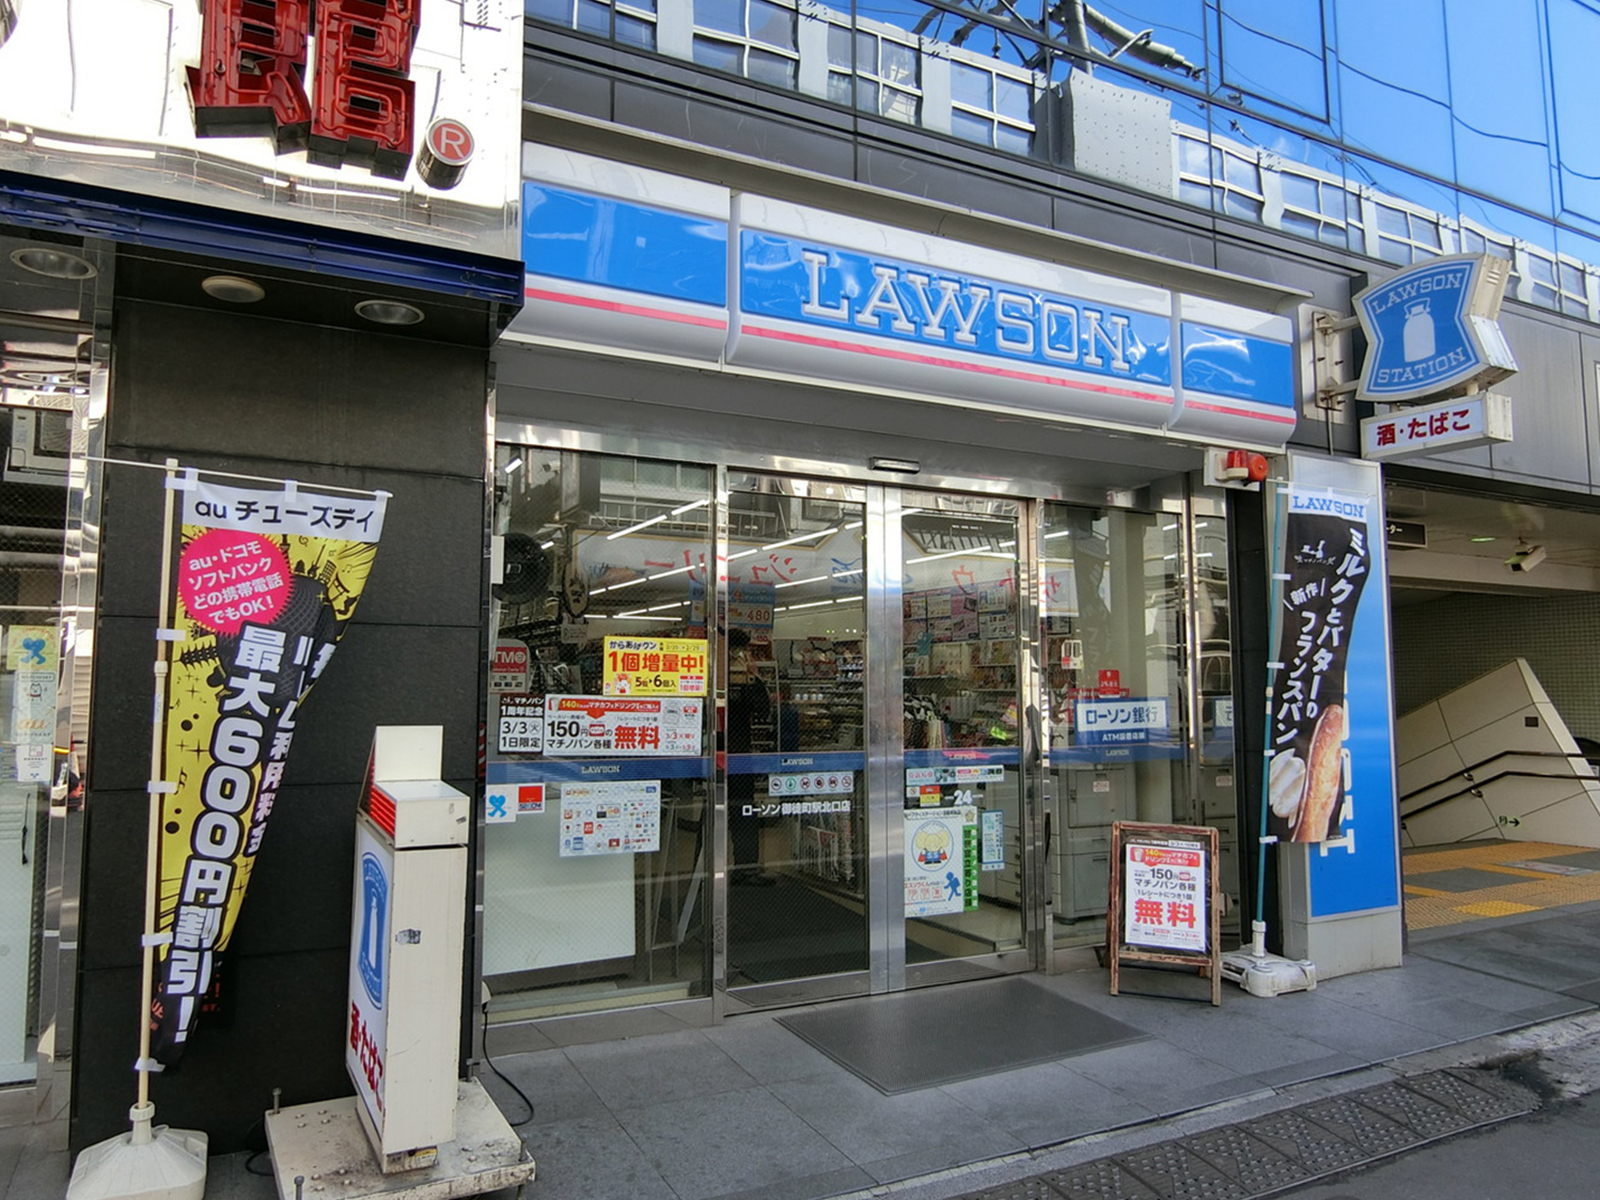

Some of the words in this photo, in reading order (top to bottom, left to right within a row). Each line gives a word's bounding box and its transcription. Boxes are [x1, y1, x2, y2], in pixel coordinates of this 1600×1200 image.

[1373, 272, 1463, 315] LAWSON
[801, 248, 1131, 372] LAWSON
[1377, 347, 1466, 384] STATION
[1376, 409, 1470, 446] 酒・たばこ
[195, 500, 228, 518] au
[1293, 495, 1364, 517] LAWSON
[188, 557, 272, 591] ソフトバンク
[194, 572, 284, 609] どの携帯電話
[1290, 582, 1319, 605] 新作
[1306, 527, 1366, 718] ミルクとバターの
[609, 641, 658, 650] からあげクン
[1276, 611, 1317, 744] フランスパン
[1085, 706, 1158, 725] ローソン銀行
[502, 737, 541, 748] 1日限定
[546, 739, 612, 749] マチノパン各種
[614, 724, 660, 750] 無料
[581, 764, 621, 774] LAWSON
[953, 789, 973, 805] 24
[1134, 878, 1196, 892] マチノパン各種
[1134, 899, 1196, 929] 無料
